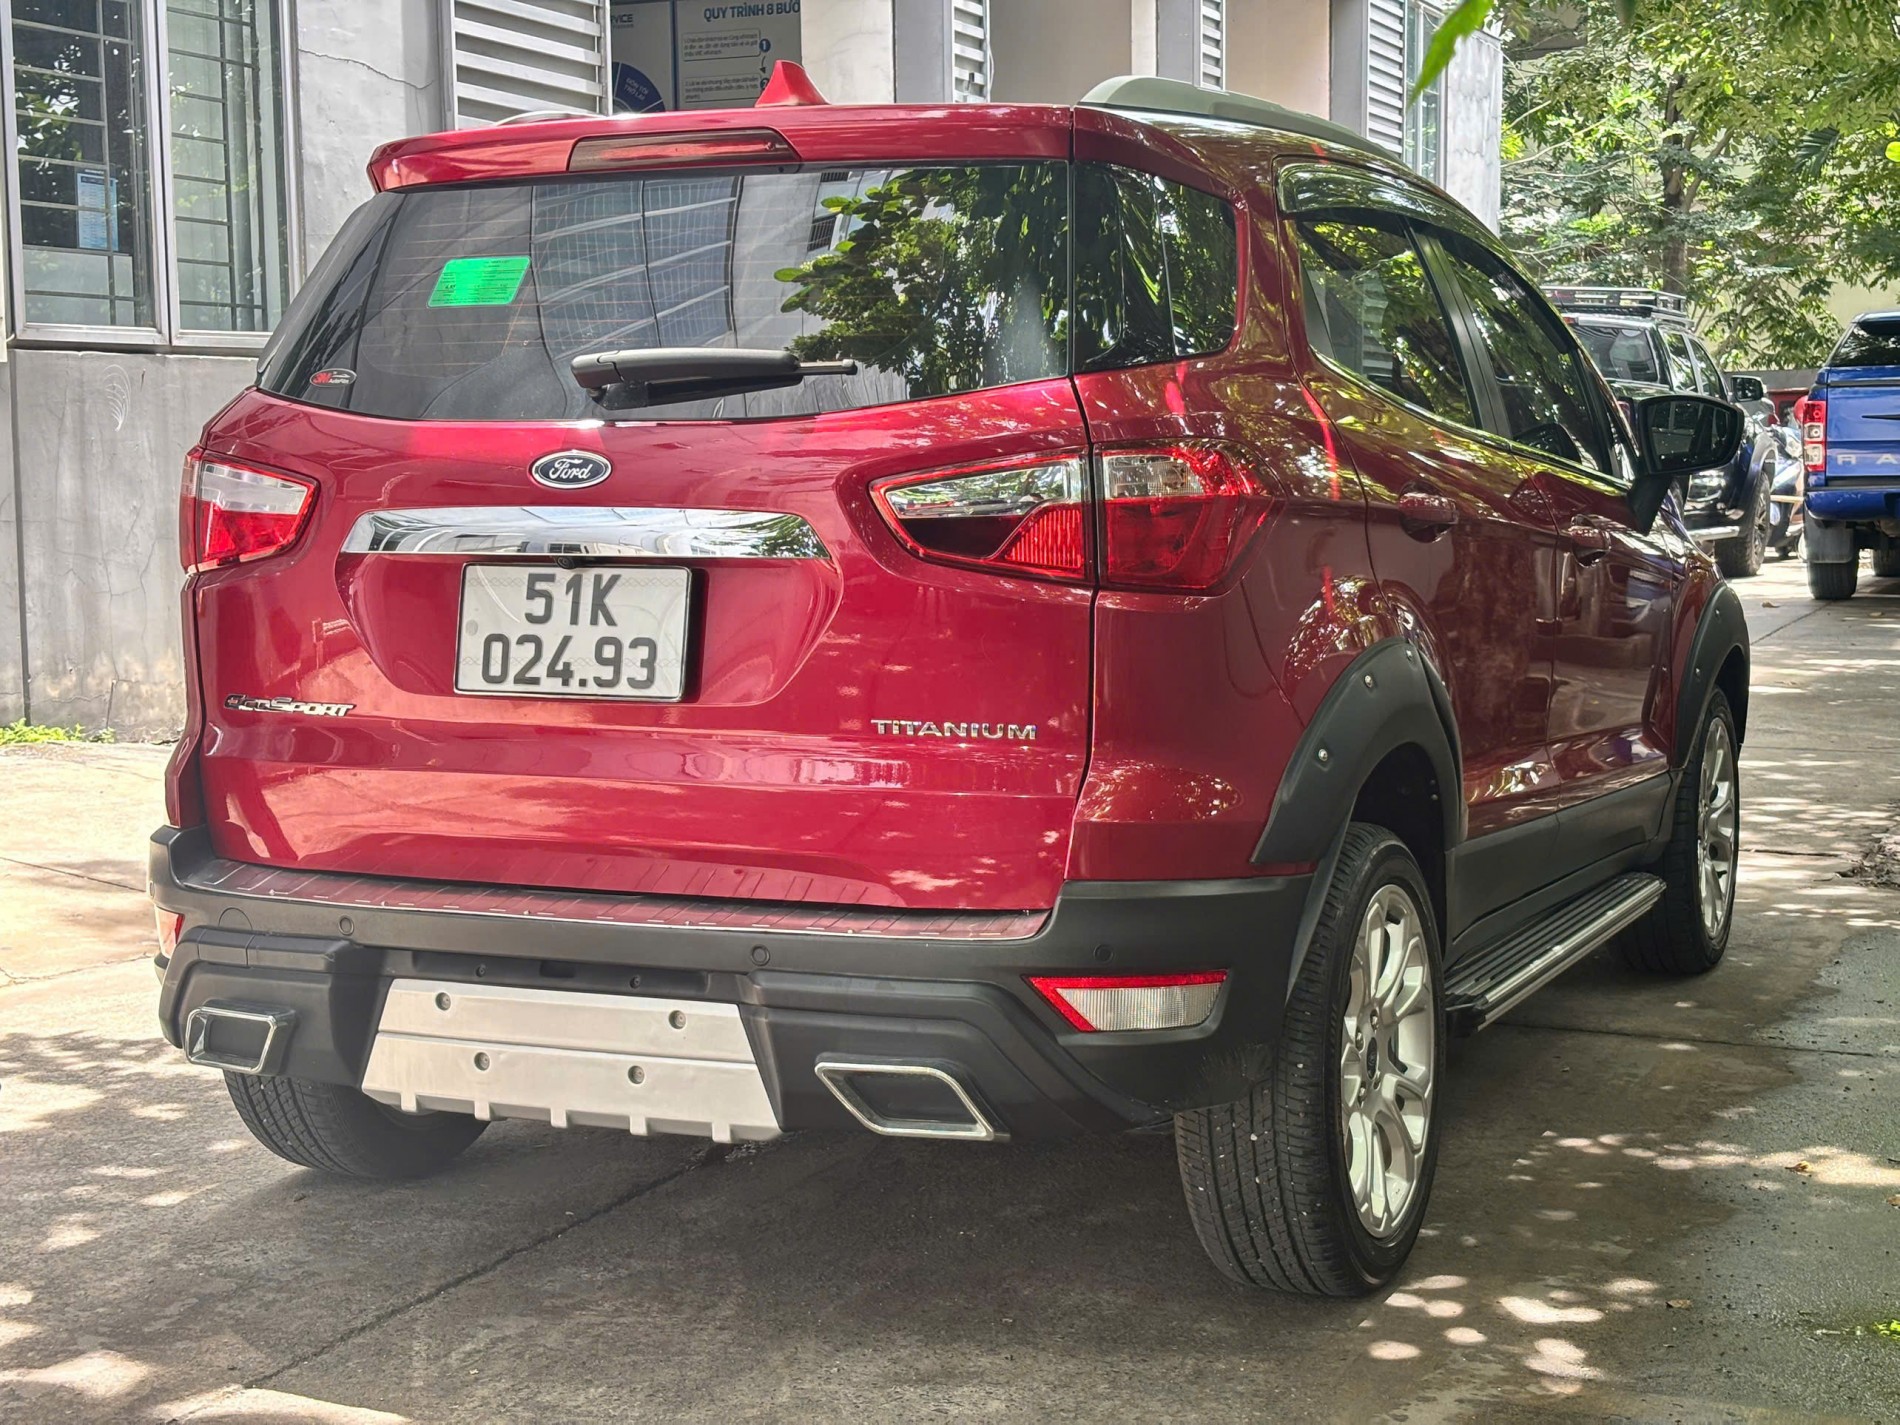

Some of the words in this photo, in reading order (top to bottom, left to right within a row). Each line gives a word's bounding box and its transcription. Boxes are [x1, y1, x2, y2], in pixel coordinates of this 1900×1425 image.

[703, 7, 728, 22] QUY
[729, 2, 765, 18] TRÌNH
[766, 3, 774, 15] 8
[548, 458, 593, 479] Ford
[525, 572, 622, 627] 51K
[481, 632, 657, 690] 024.93
[870, 719, 1037, 740] TITANIUM
